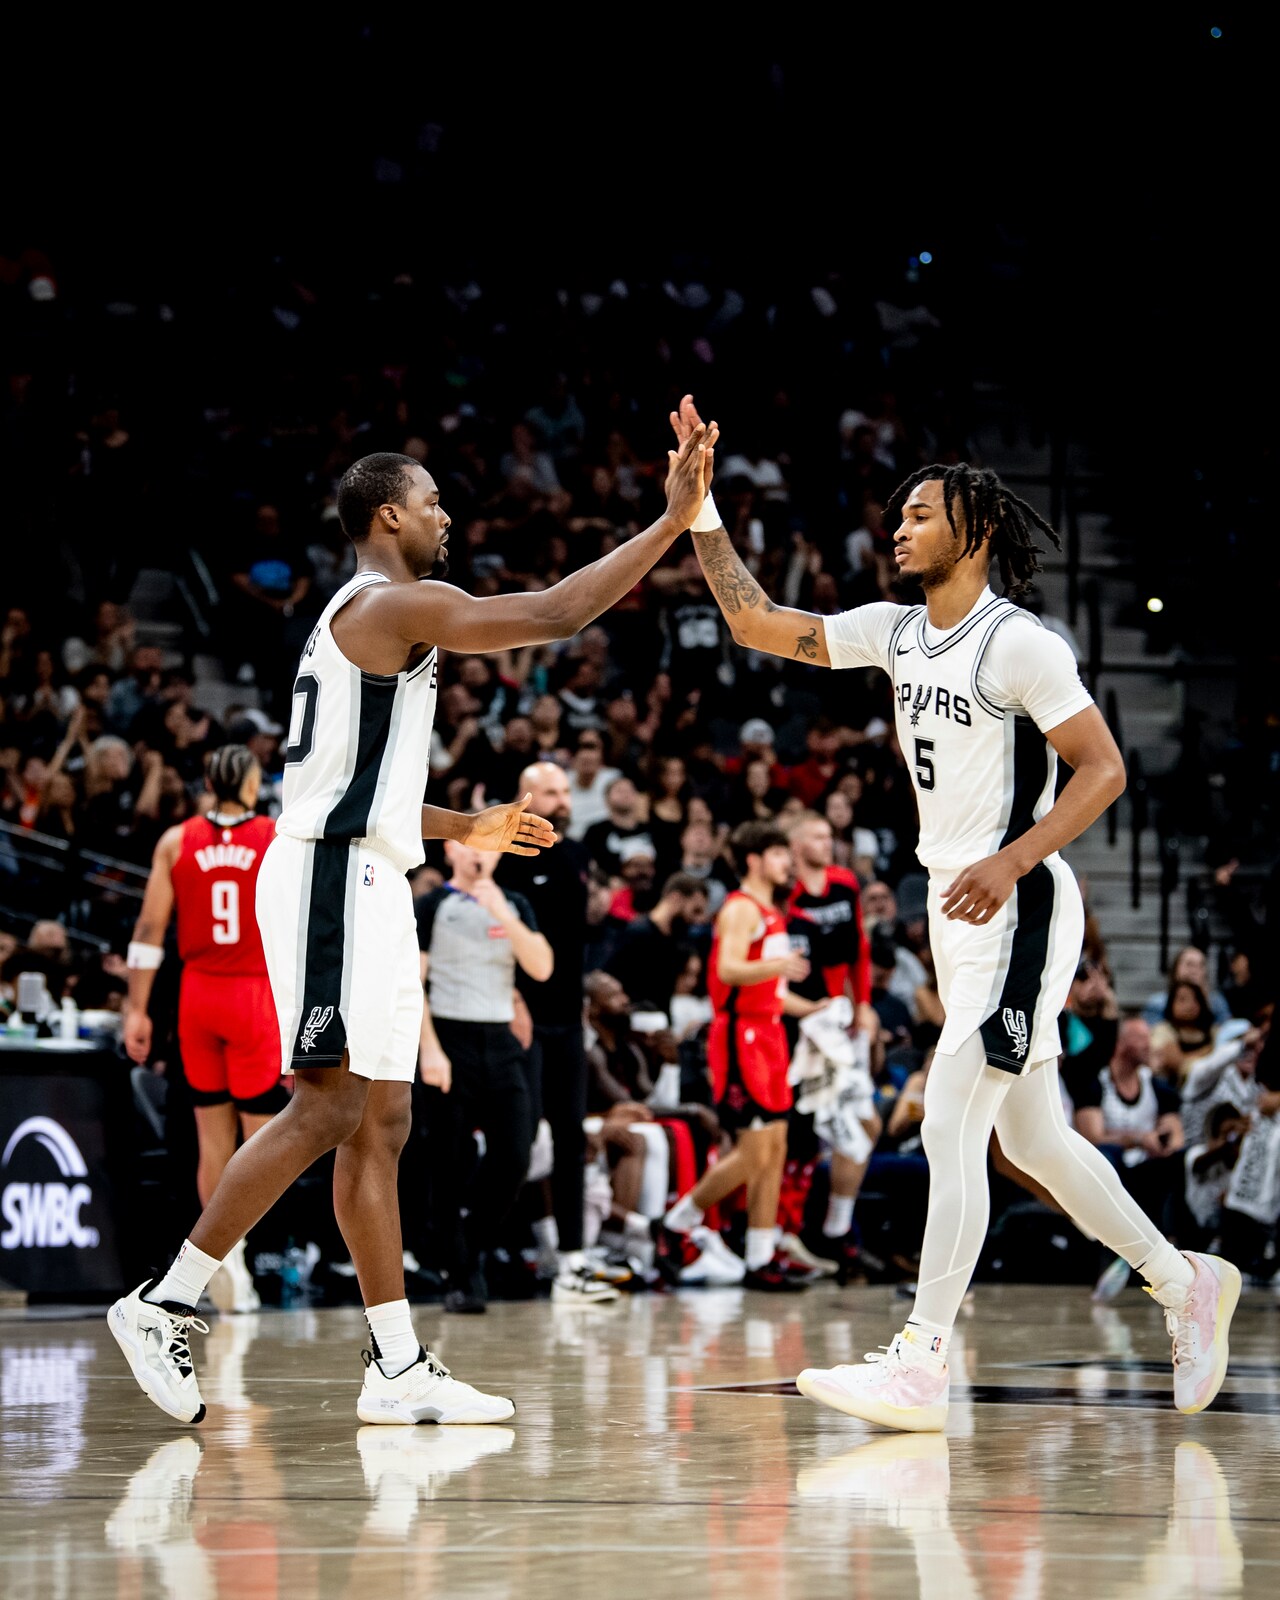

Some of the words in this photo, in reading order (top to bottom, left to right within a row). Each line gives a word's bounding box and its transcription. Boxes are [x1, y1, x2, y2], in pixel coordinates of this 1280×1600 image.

[913, 735, 936, 793] 5
[211, 880, 240, 945] 9
[1, 1182, 93, 1249] SWBC
